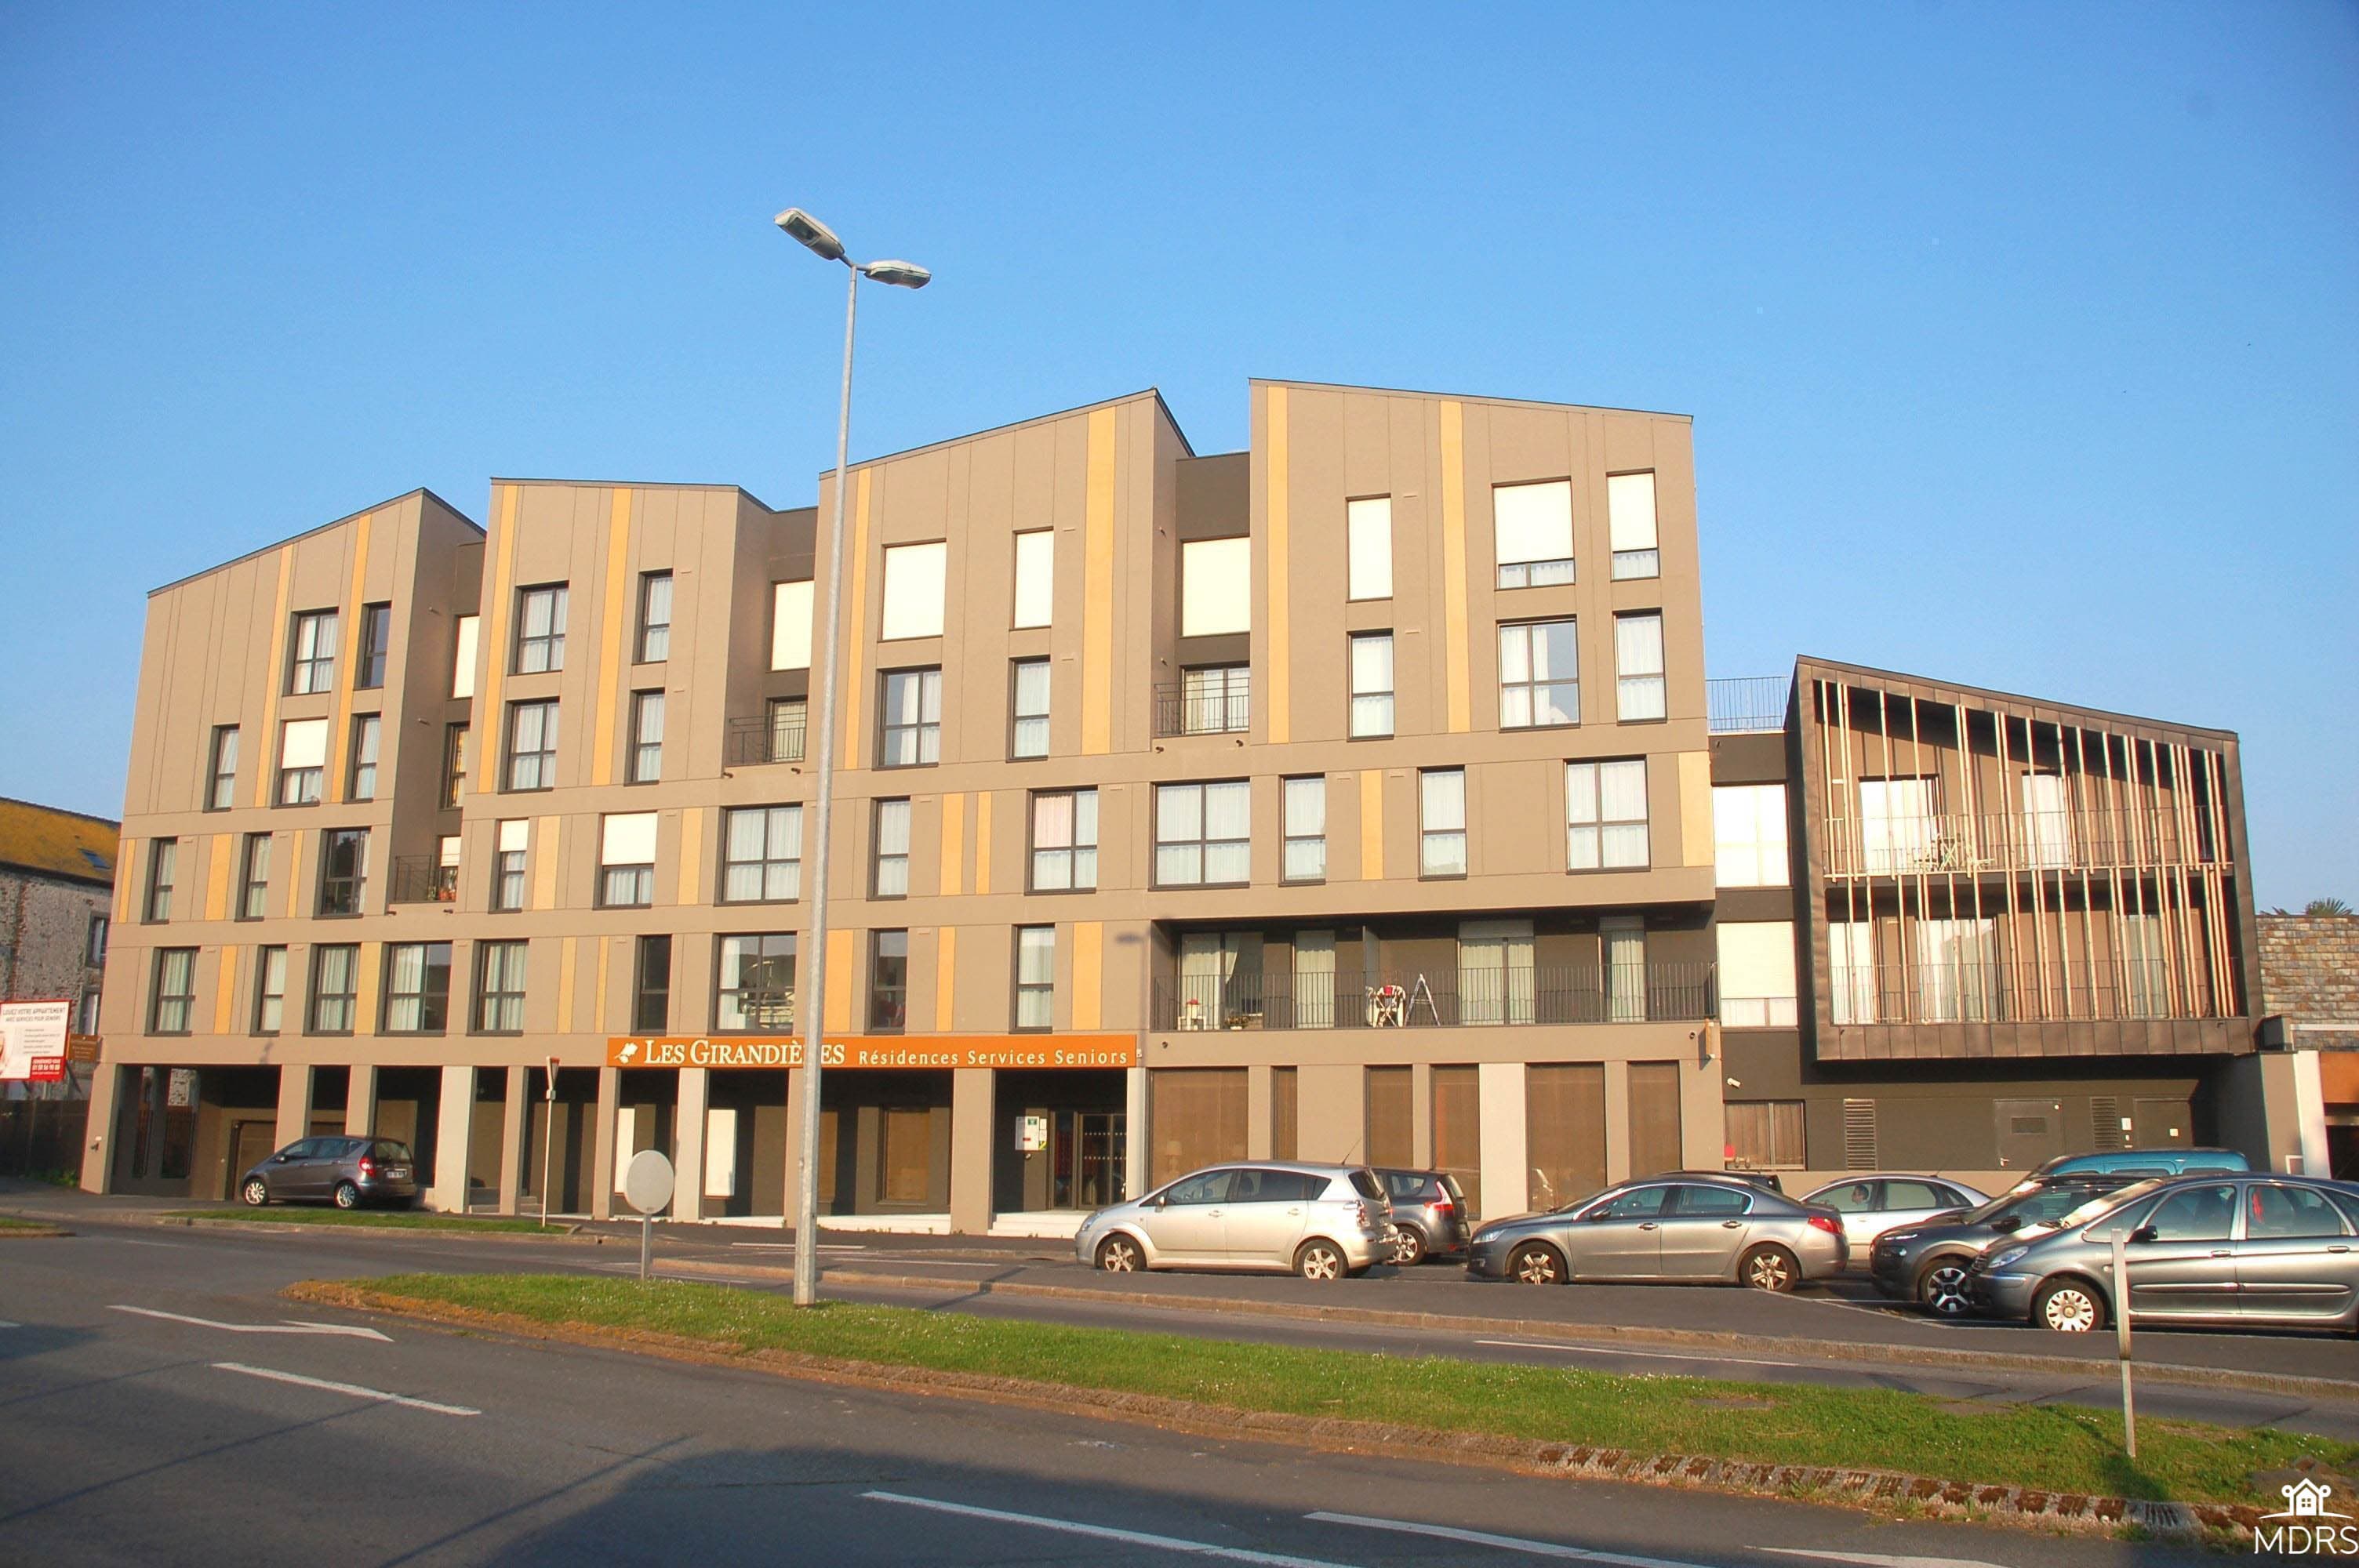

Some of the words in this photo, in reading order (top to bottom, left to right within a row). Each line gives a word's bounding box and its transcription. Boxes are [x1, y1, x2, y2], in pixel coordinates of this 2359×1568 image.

[645, 1040, 685, 1065] LES
[690, 1039, 845, 1065] GIRANDIÈES
[859, 1050, 958, 1065] Résidences
[968, 1050, 1045, 1065] Services
[1055, 1049, 1127, 1065] Seniors
